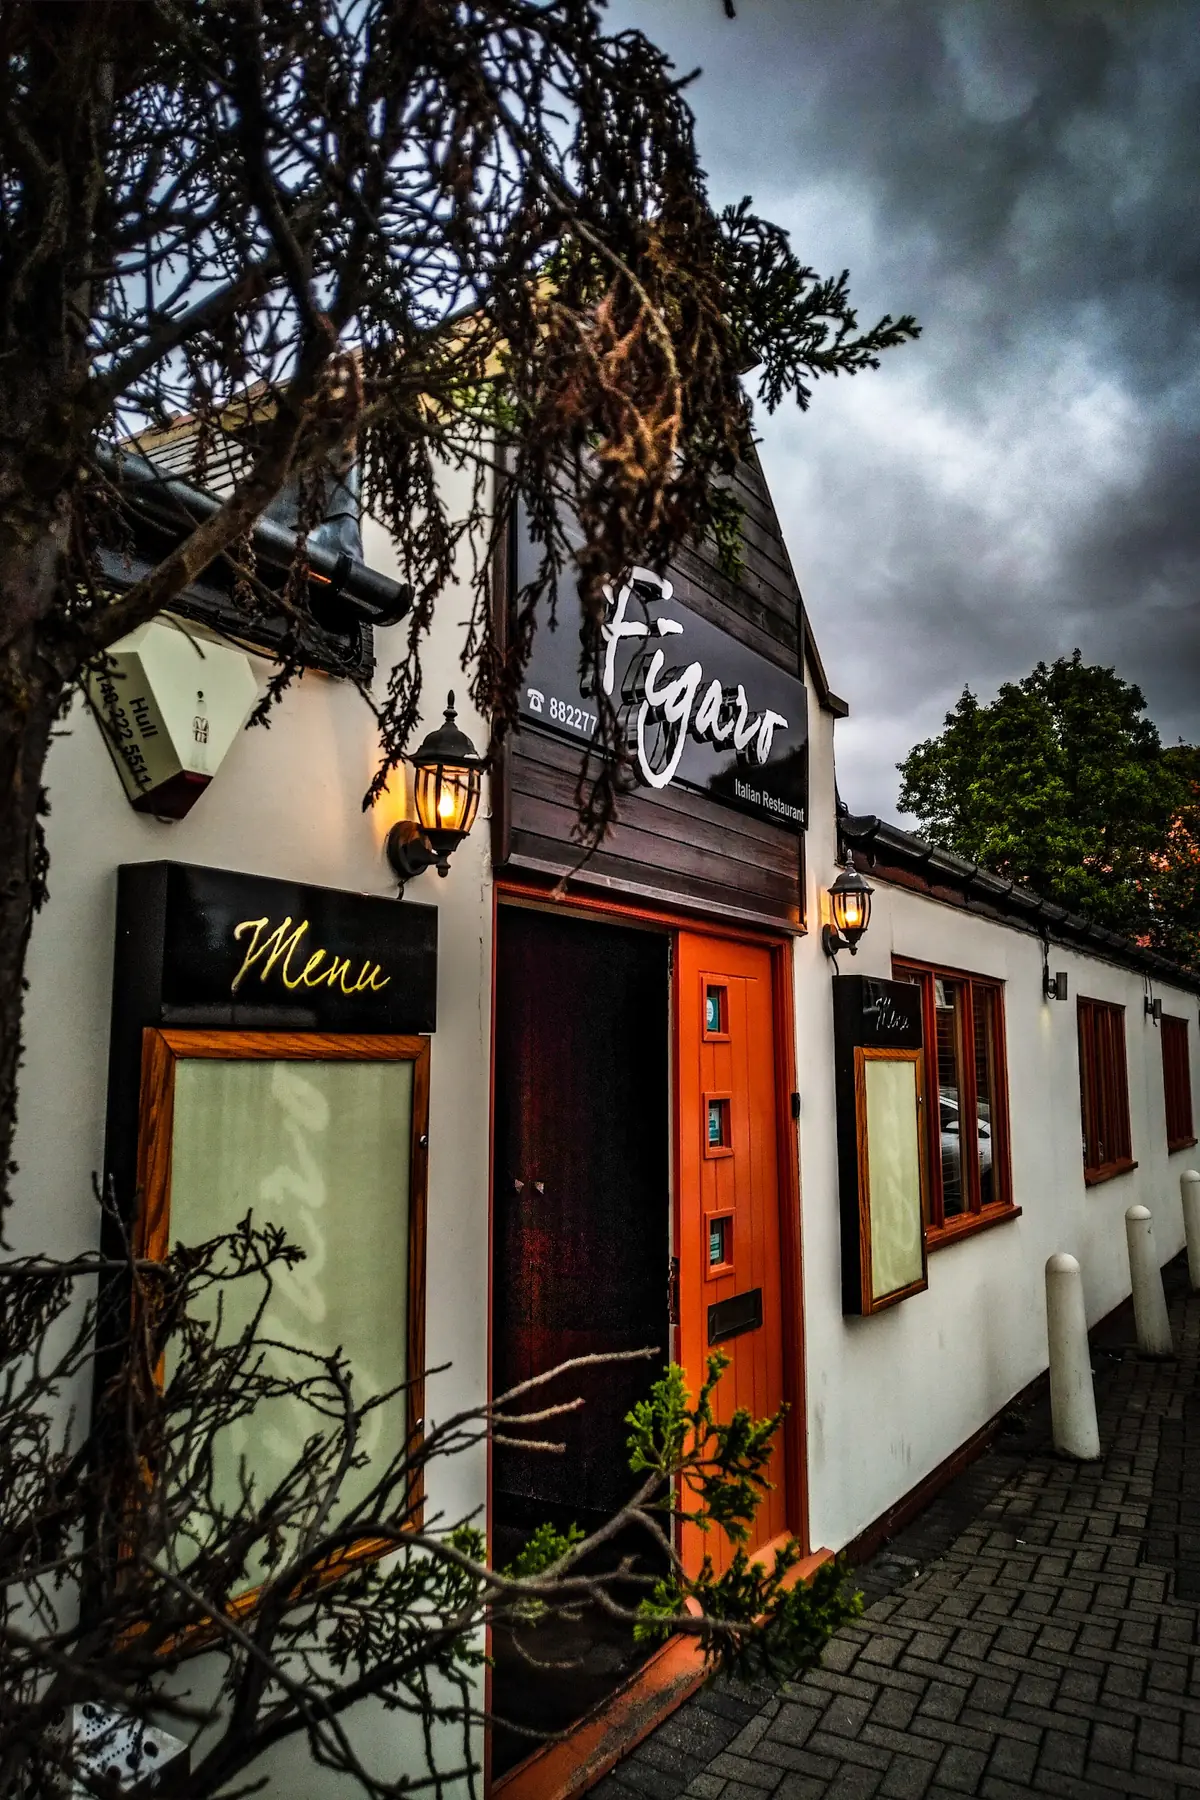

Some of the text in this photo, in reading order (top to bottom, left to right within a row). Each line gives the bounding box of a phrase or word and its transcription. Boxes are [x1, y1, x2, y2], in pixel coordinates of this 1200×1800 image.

[600, 565, 789, 789] Figaro
[129, 697, 159, 739] Hull
[549, 697, 598, 735] 882277
[734, 778, 805, 823] Italian Restaurant
[230, 916, 391, 994] Menu
